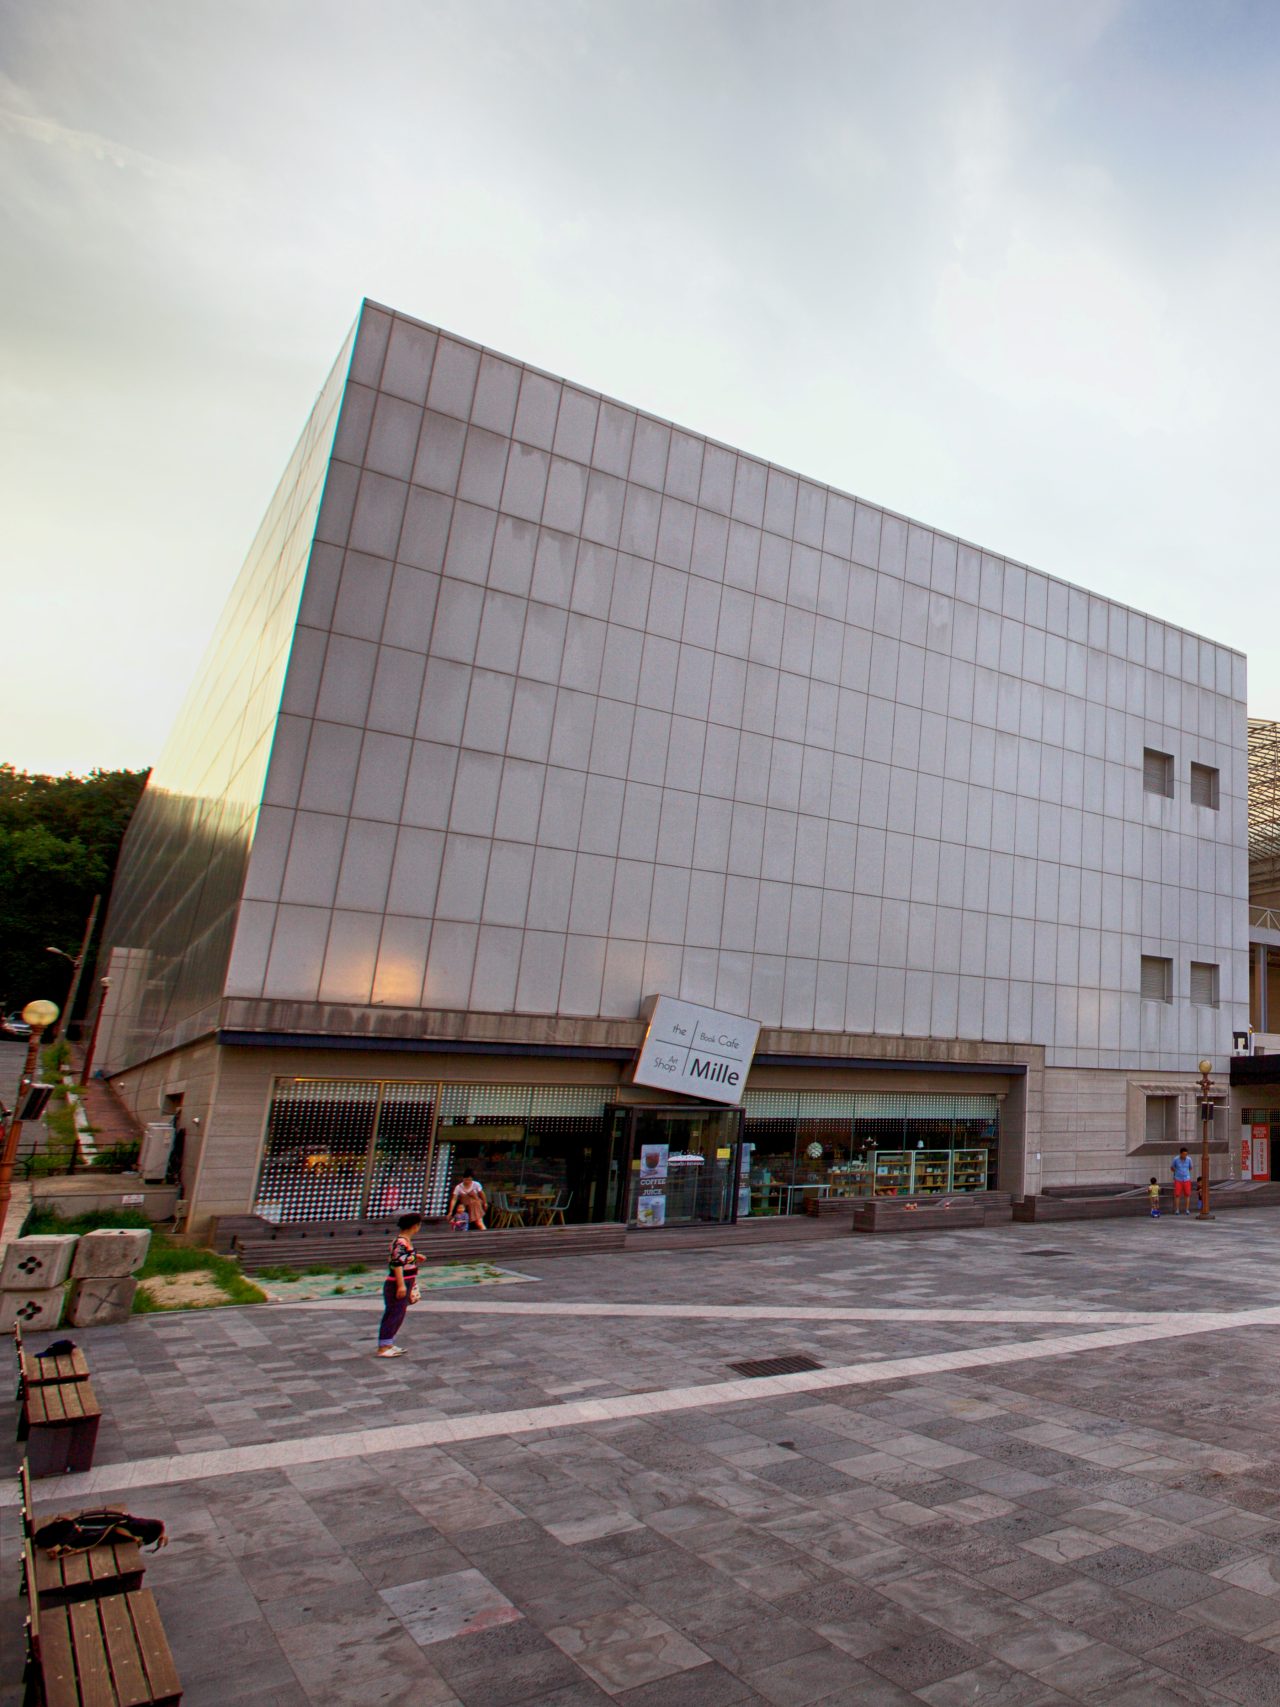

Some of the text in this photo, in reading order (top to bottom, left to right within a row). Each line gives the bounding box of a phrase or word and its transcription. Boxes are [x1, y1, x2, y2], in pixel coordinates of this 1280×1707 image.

[673, 1024, 687, 1036] the
[700, 1032, 740, 1049] Book Cafe
[654, 1056, 676, 1072] Shop
[668, 1055, 678, 1064] Art
[690, 1058, 739, 1086] Mille
